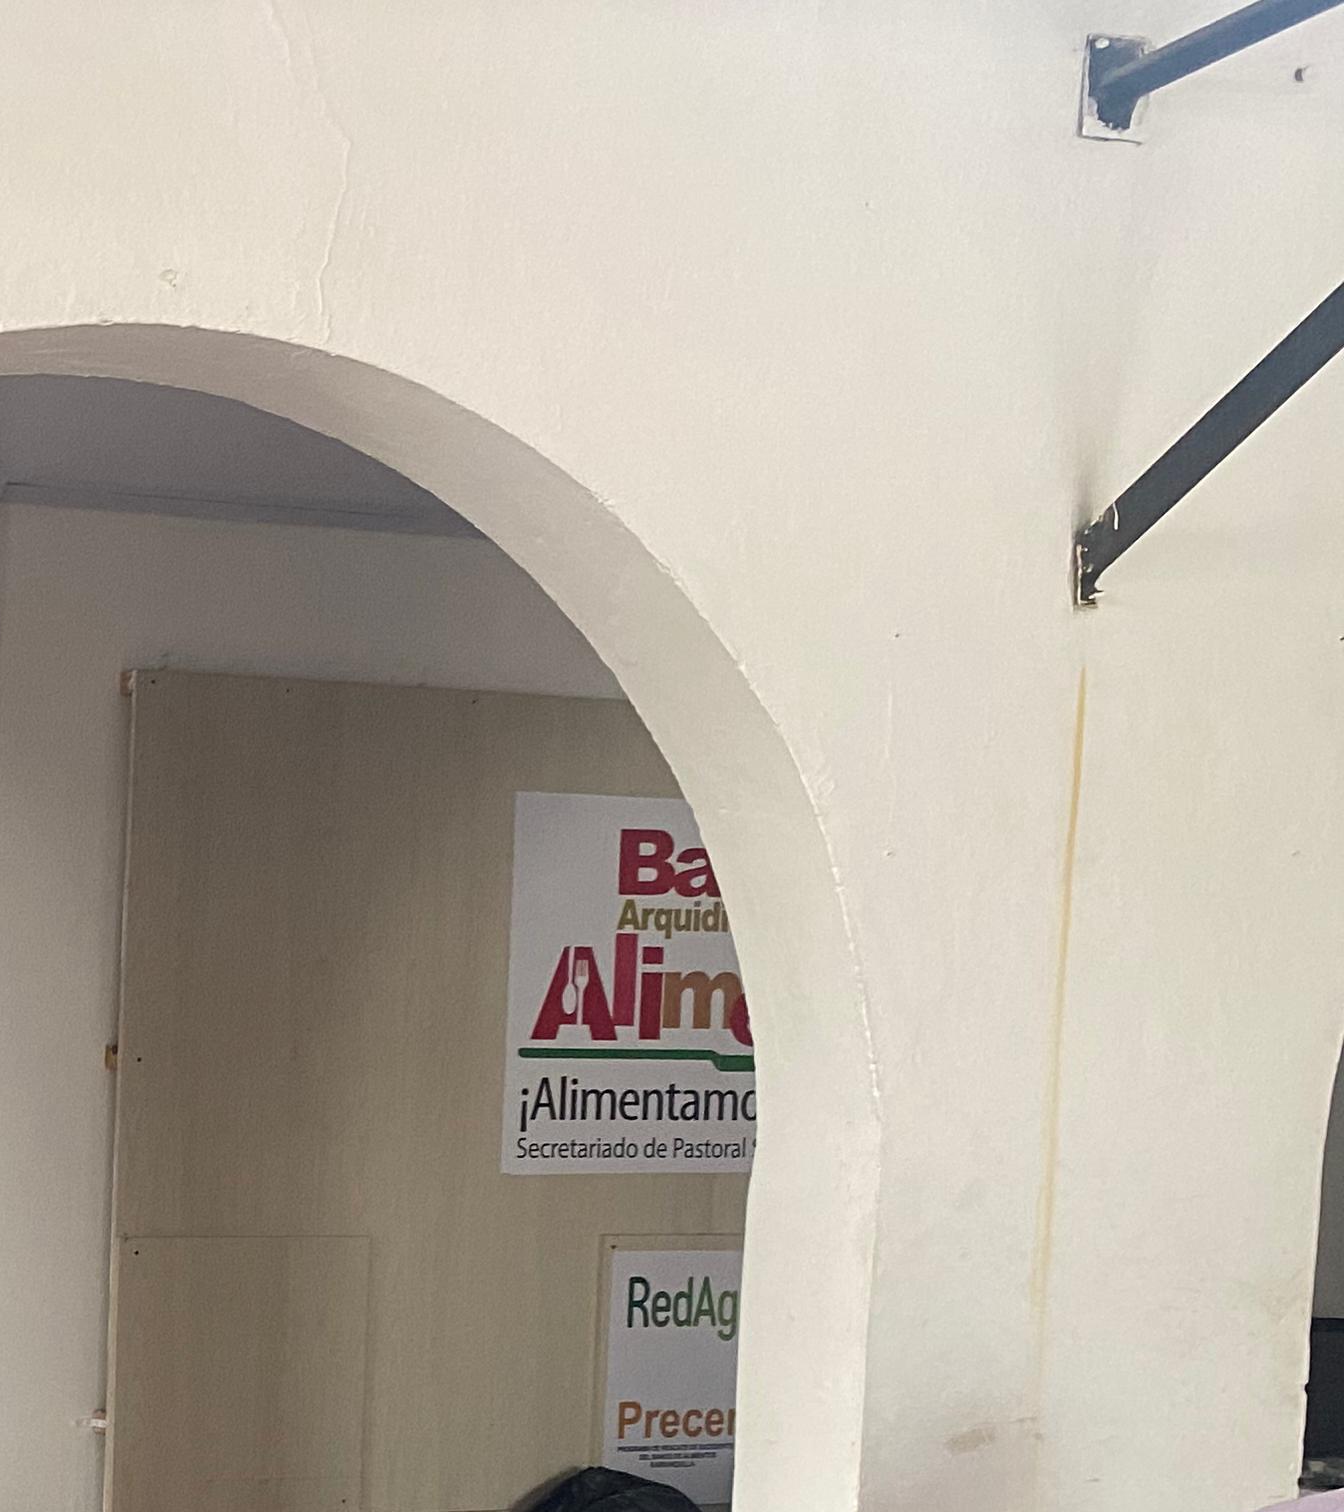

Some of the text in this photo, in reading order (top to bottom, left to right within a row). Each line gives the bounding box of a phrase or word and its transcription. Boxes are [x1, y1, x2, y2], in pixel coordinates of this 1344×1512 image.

[618, 828, 722, 898] Ba
[516, 1137, 639, 1159] Secretariado
[643, 1137, 668, 1159] de
[672, 1137, 748, 1159] Pastoral
[627, 1276, 738, 1341] RedAg
